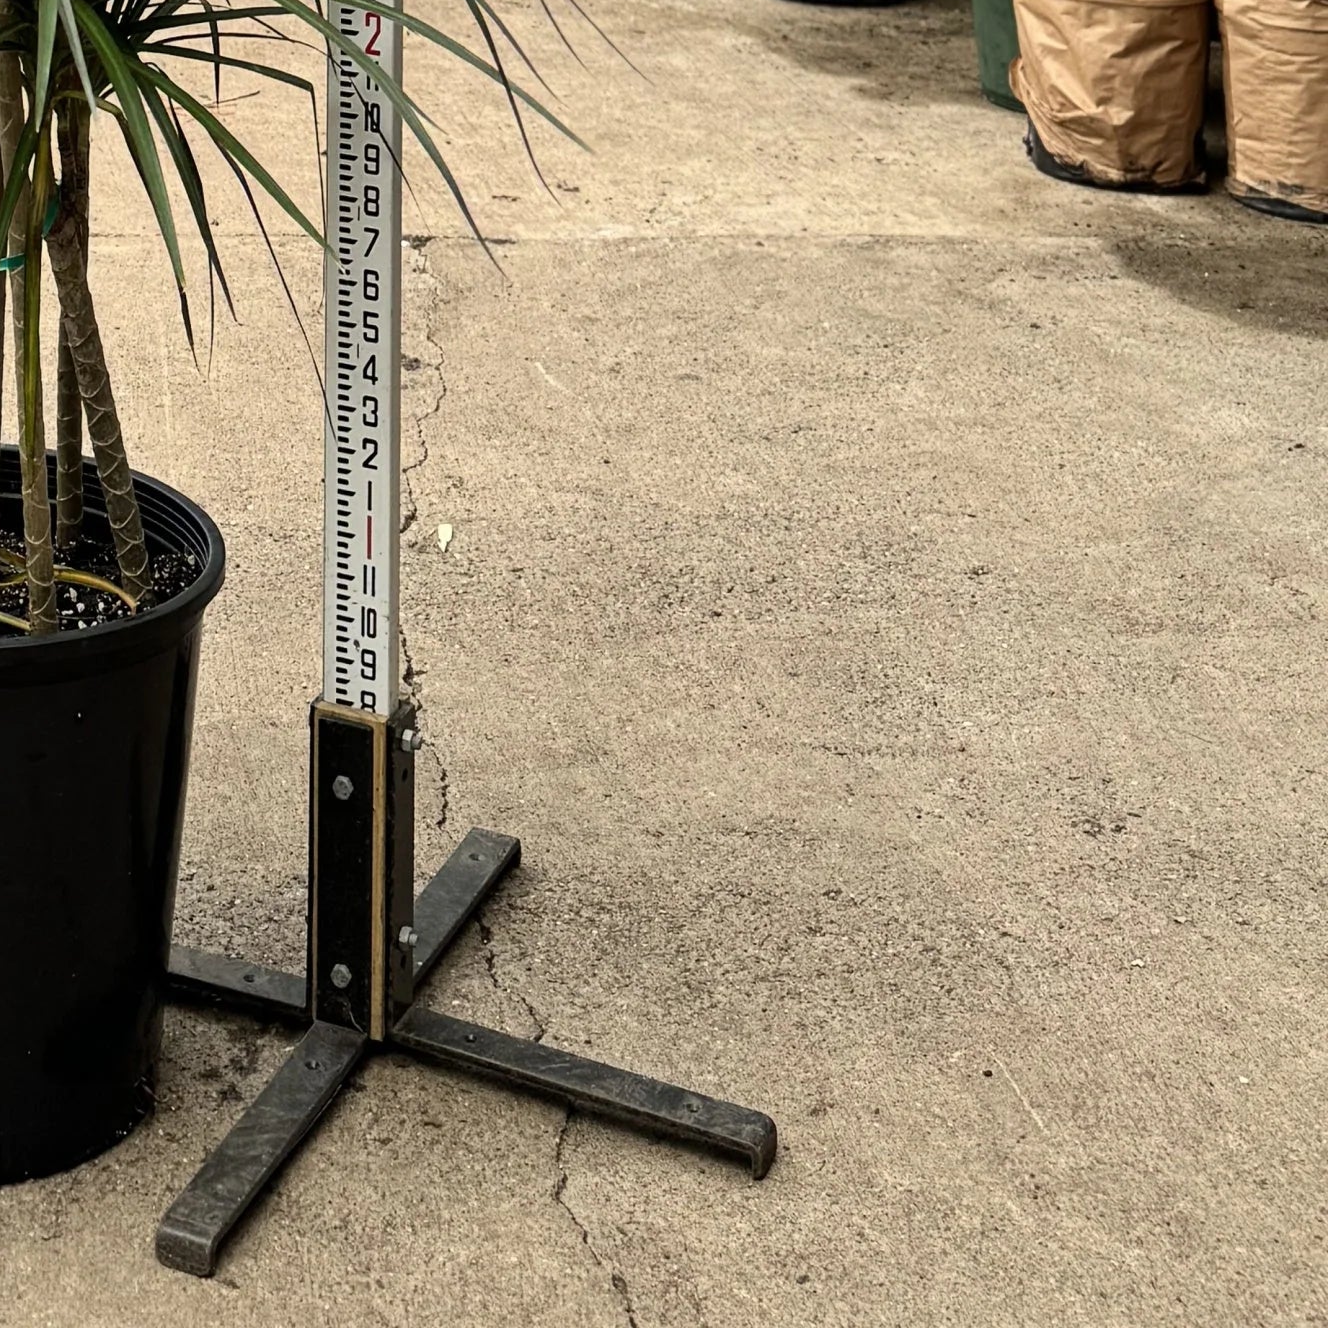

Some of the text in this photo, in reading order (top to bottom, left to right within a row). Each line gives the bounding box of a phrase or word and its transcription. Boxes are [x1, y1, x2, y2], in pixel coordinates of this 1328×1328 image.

[365, 12, 381, 56] 2
[364, 144, 380, 175] 9
[364, 185, 380, 217] 8
[364, 227, 380, 257] 7
[363, 269, 379, 301] 6
[363, 311, 379, 344] 5
[362, 355, 378, 385] 4
[362, 395, 378, 427] 3
[362, 438, 378, 470] 2
[363, 564, 376, 597] 11
[361, 606, 377, 639] 10
[361, 649, 376, 681] 9
